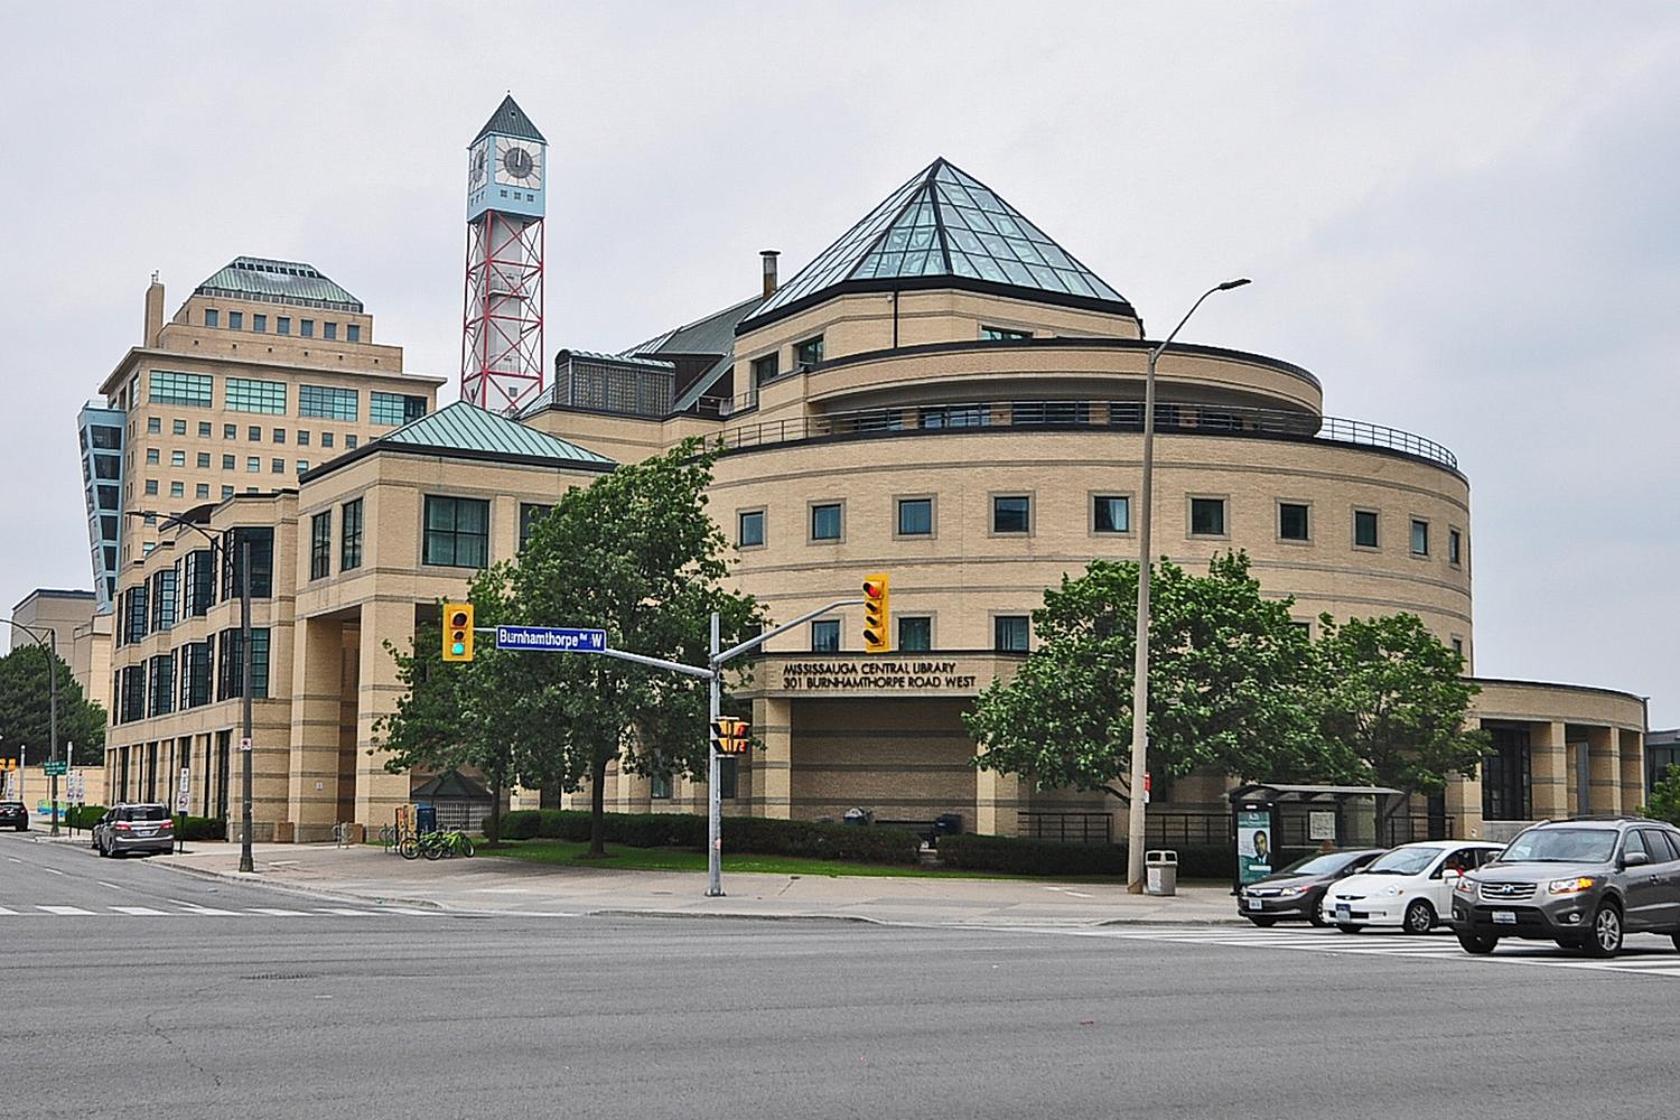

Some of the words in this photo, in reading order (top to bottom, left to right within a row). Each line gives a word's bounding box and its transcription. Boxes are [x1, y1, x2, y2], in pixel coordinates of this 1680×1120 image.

[500, 629, 578, 650] Burnhamthorpe
[592, 633, 602, 648] W
[783, 662, 858, 676] MISSISSAUGA
[861, 662, 910, 675] CENTRAL
[913, 662, 956, 675] LIBRARY
[783, 676, 802, 689] 301
[807, 676, 905, 689] BURNHAMTHORPE
[908, 676, 941, 688] ROAD
[945, 676, 976, 688] WEST
